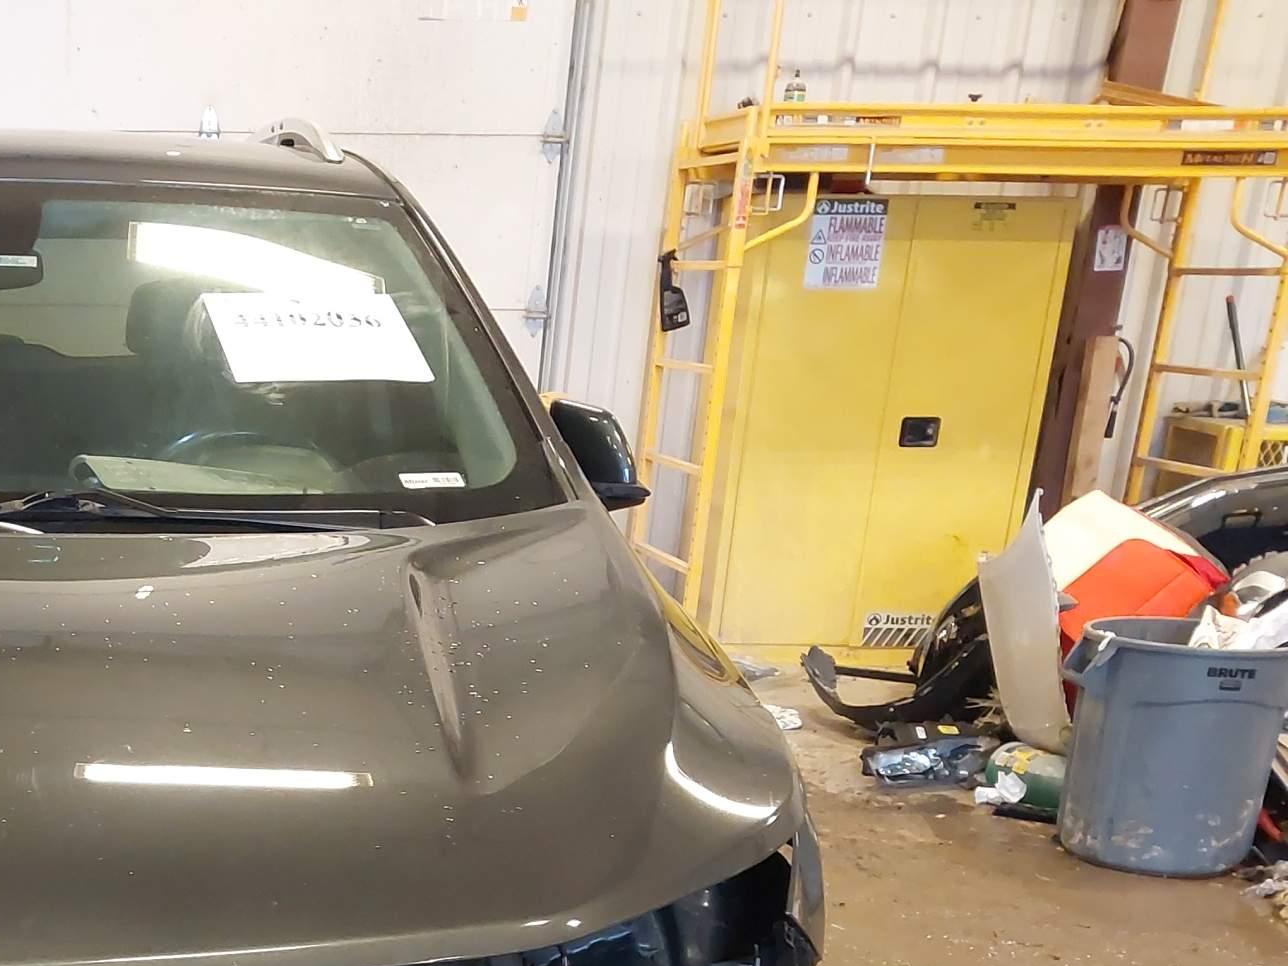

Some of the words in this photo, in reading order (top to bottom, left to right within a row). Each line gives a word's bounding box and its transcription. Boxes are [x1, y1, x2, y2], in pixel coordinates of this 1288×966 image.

[831, 200, 885, 213] Justrite
[828, 217, 885, 233] FLAMMABLE
[883, 614, 934, 625] Justrit
[1207, 667, 1256, 679] BRUTE
